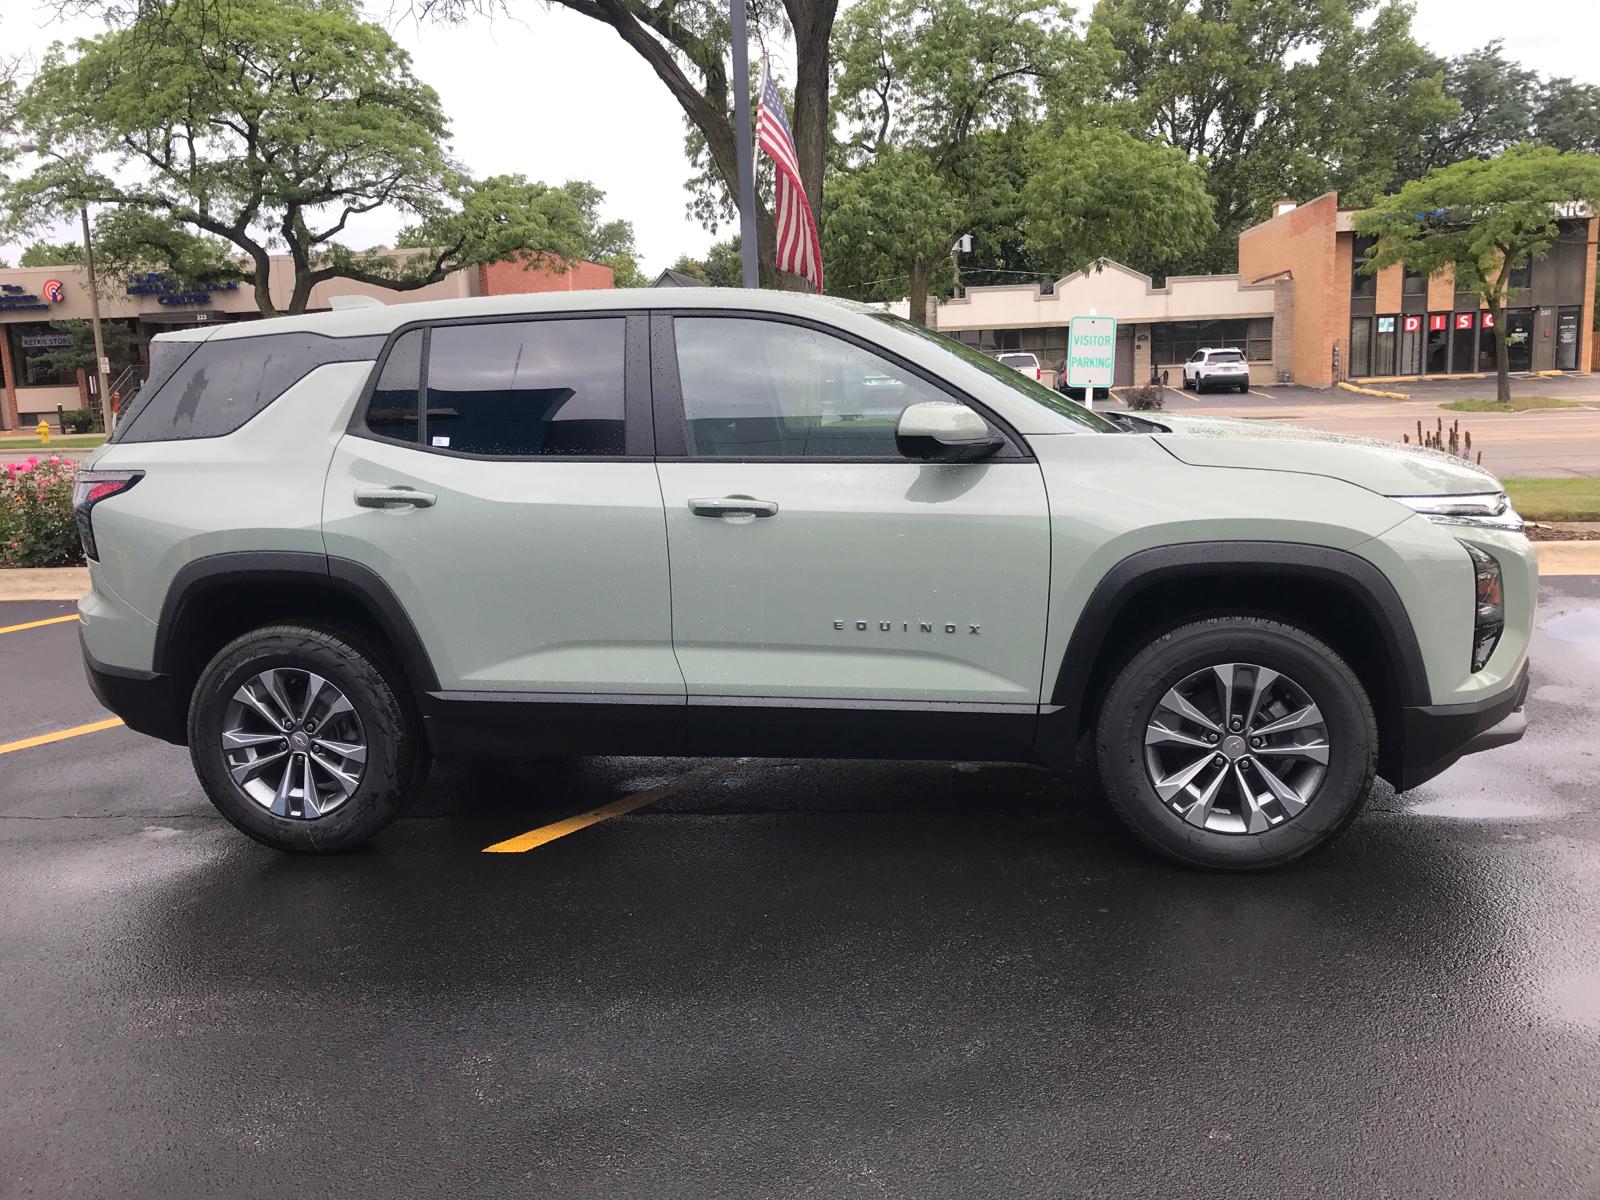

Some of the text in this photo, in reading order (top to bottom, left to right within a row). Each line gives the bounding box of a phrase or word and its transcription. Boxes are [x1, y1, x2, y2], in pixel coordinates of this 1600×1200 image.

[1074, 335, 1111, 346] VISITOR
[1071, 357, 1111, 368] PARKING
[833, 620, 981, 635] EQUINOX
